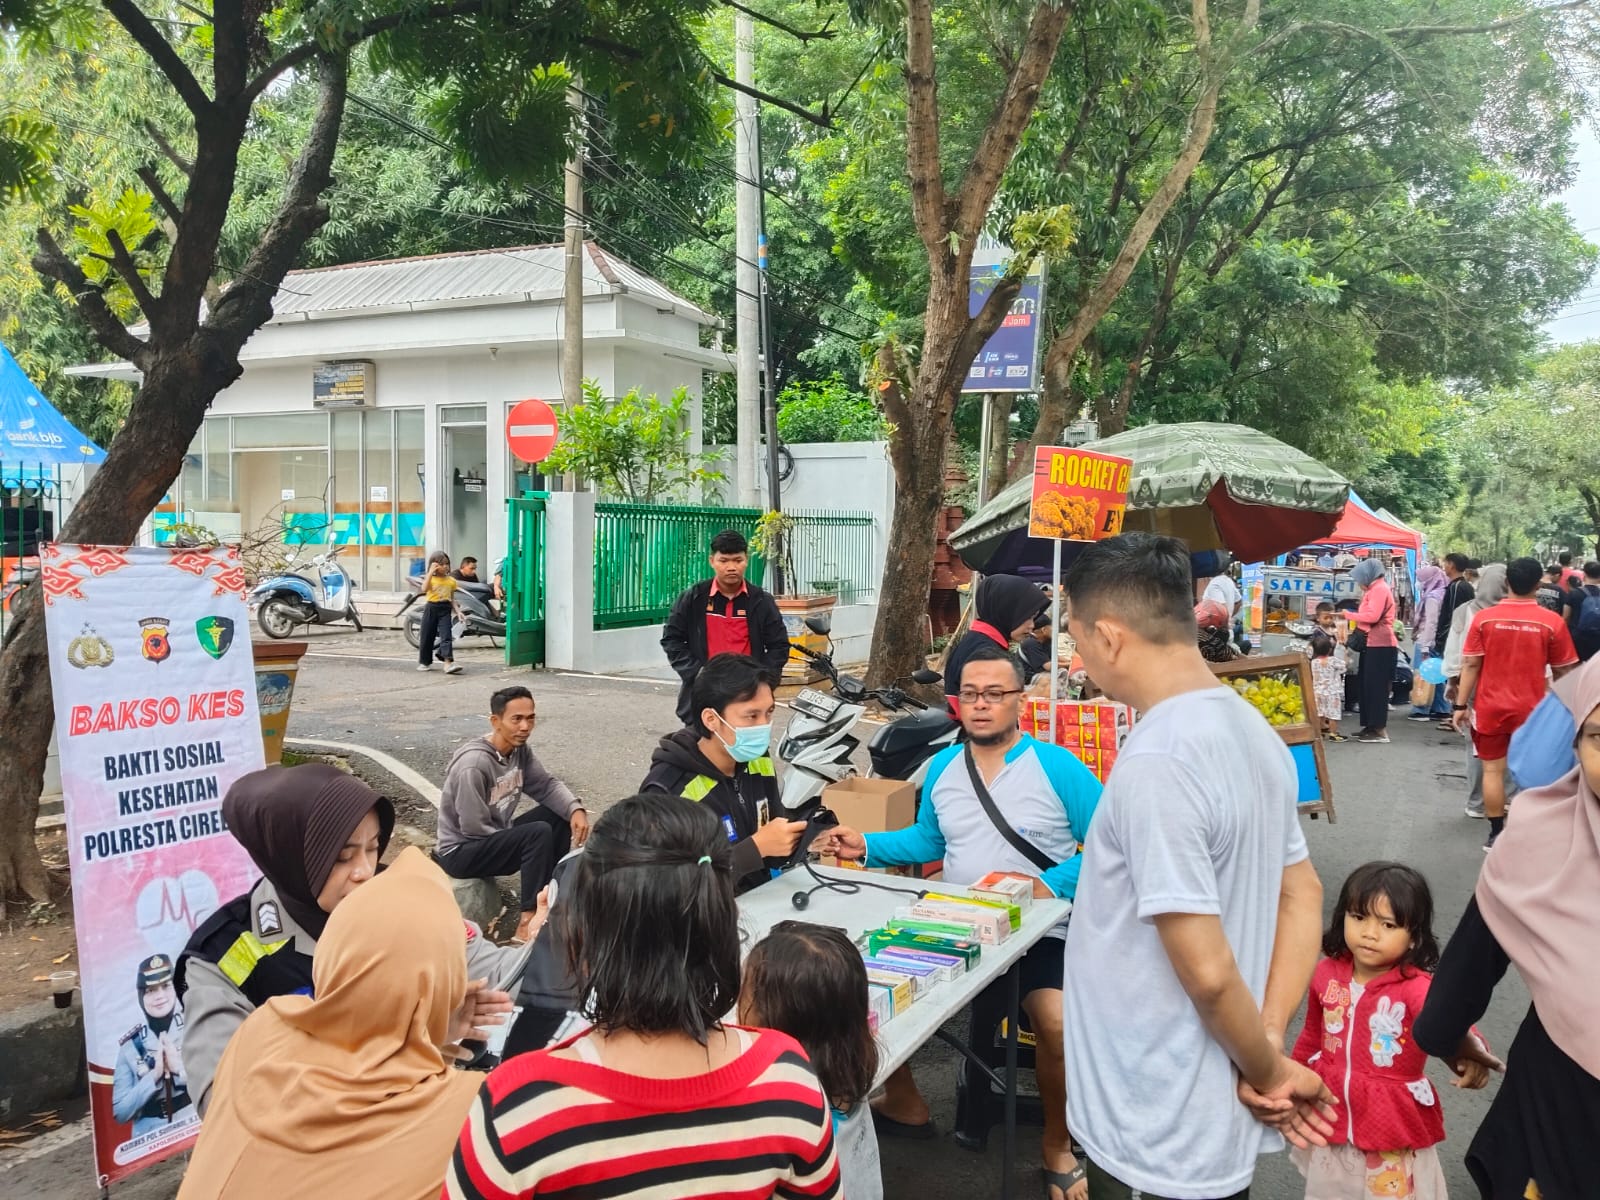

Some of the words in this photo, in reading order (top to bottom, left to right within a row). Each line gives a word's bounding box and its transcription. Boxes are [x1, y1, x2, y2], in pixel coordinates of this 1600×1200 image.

[39, 432, 62, 444] bjb
[1050, 453, 1118, 491] ROCKET
[1270, 578, 1315, 591] SATE
[69, 697, 181, 736] BAKSO
[187, 689, 245, 722] KES
[104, 749, 160, 781] BAKTI
[163, 740, 225, 771] SOSIAL
[118, 775, 219, 816] KESEHATAN
[84, 819, 177, 861] POLRESTA
